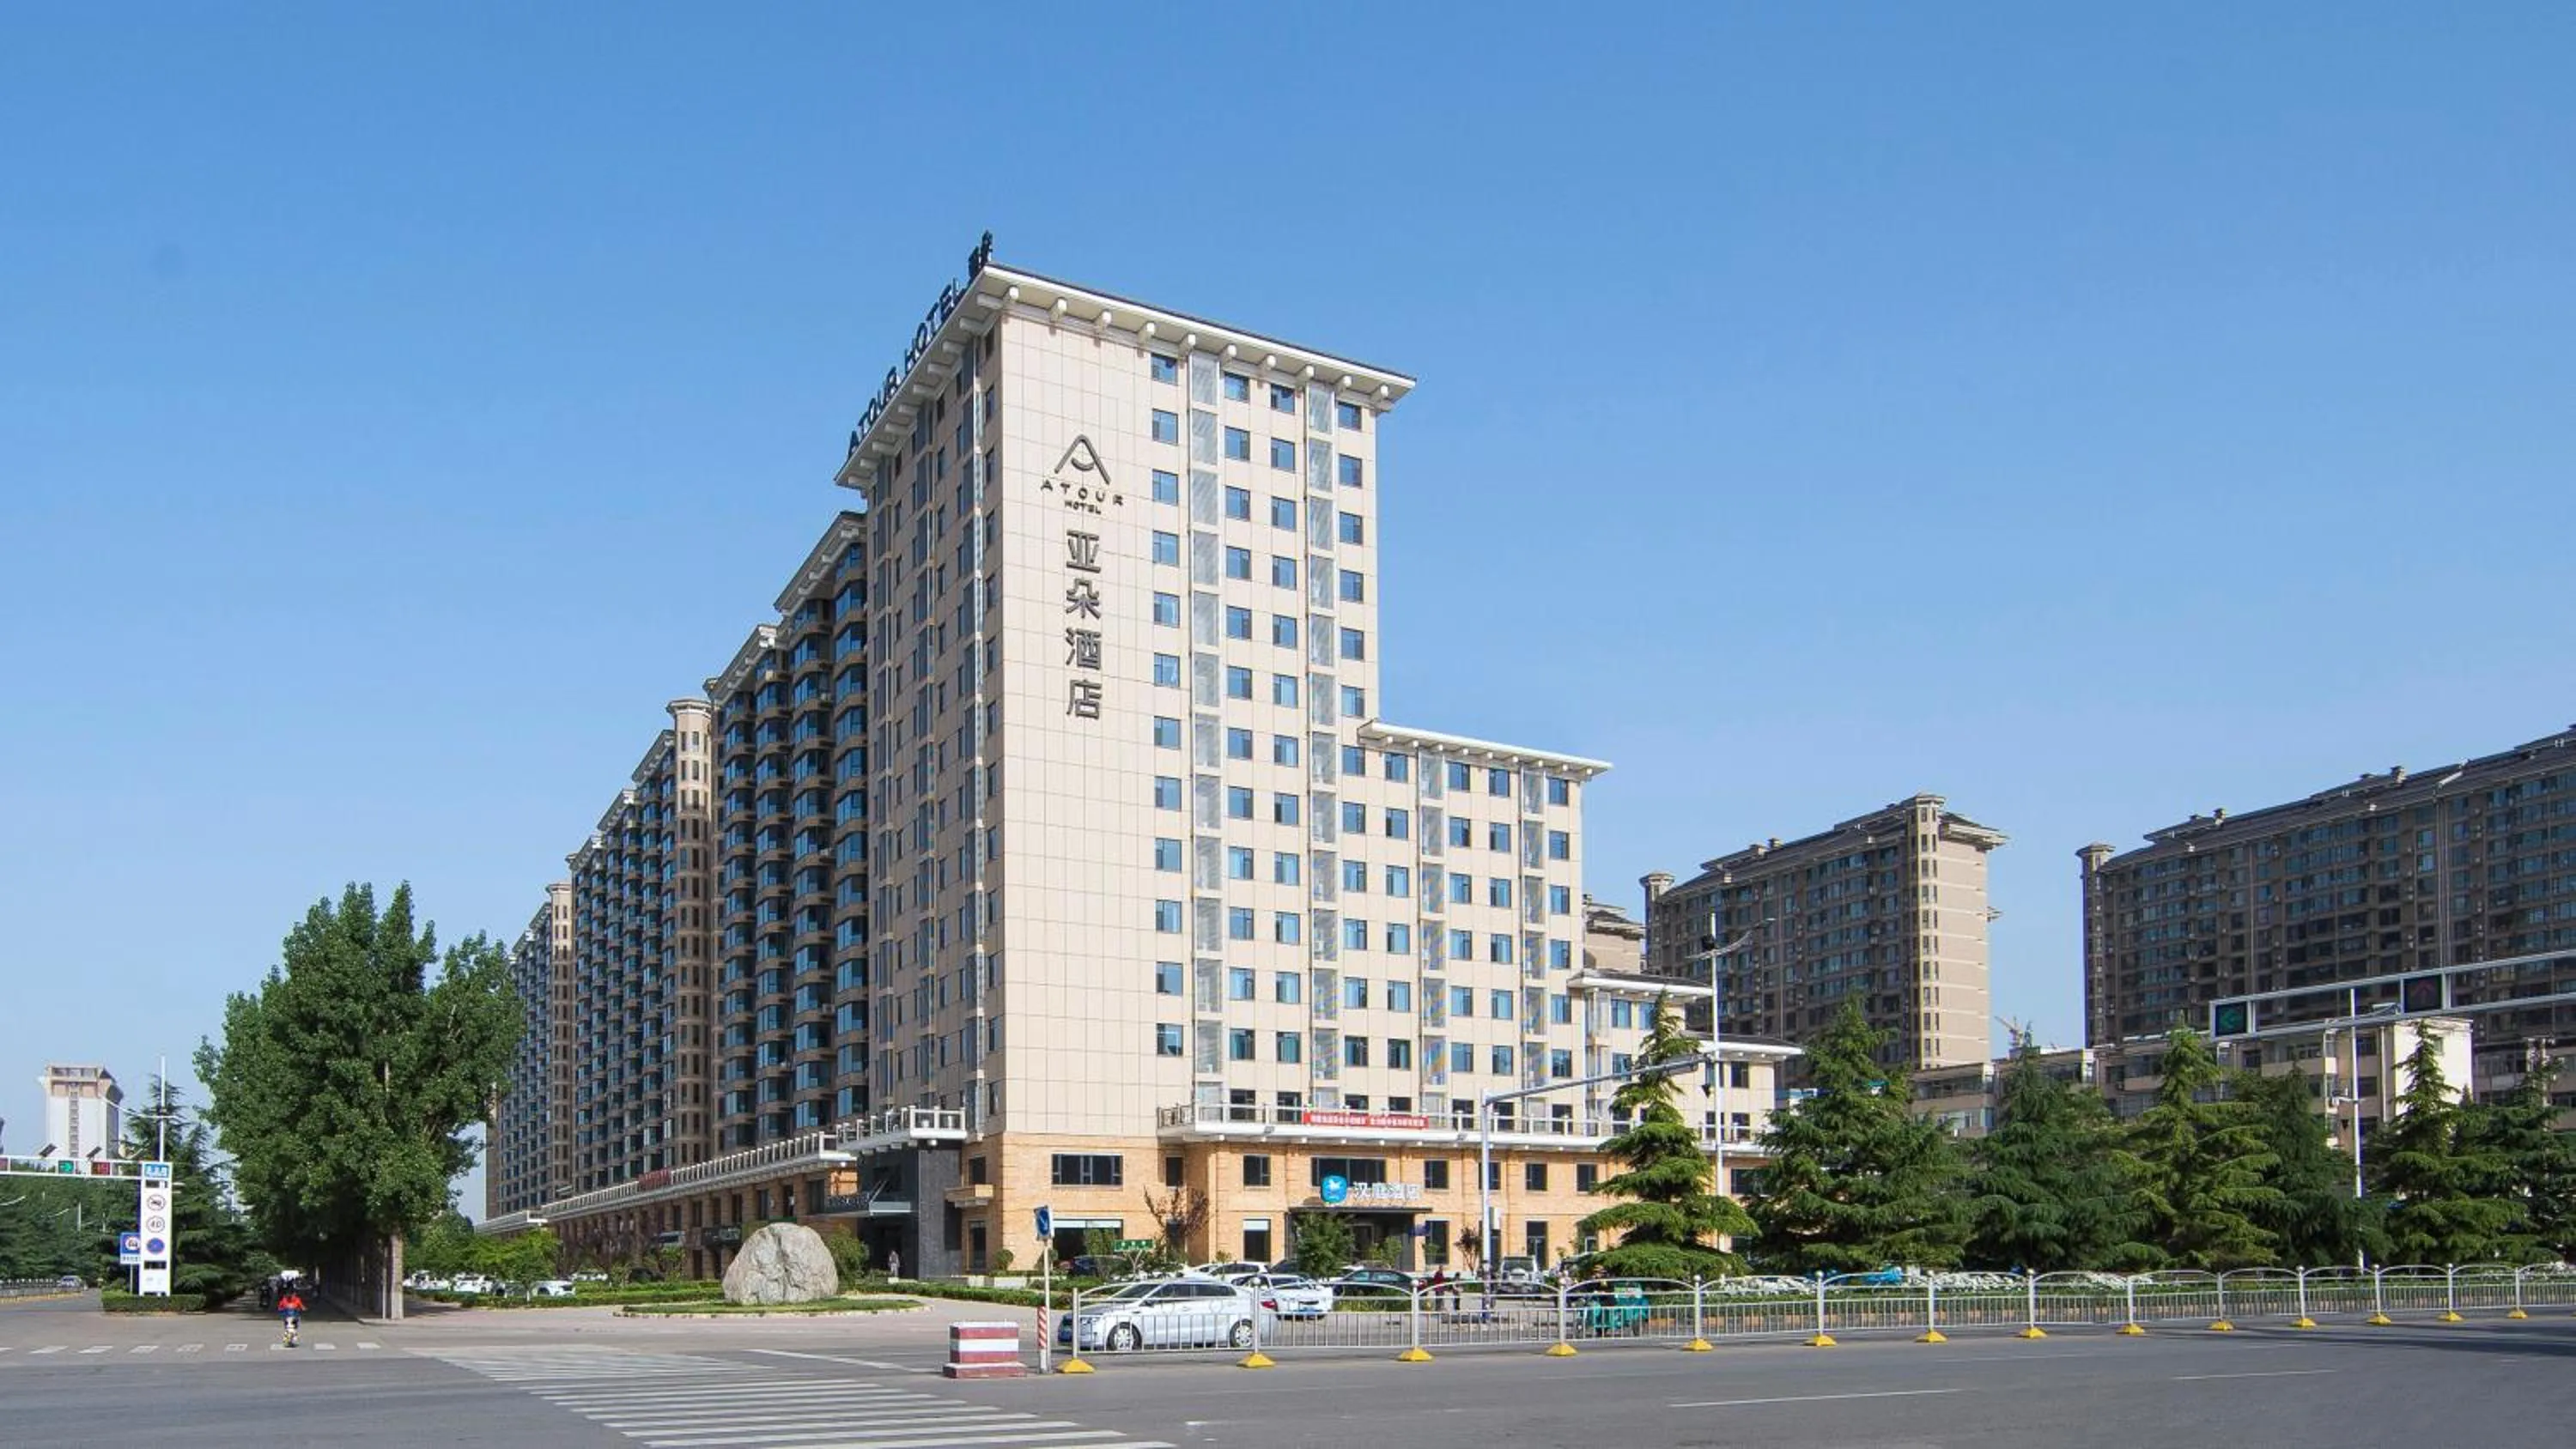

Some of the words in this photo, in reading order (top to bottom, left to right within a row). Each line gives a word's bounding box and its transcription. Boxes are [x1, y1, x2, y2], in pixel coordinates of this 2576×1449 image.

[848, 365, 902, 460] ATOUR
[904, 276, 968, 374] HOTEL
[1041, 479, 1123, 506] ATOUR
[1064, 500, 1102, 515] HOTEL
[1065, 529, 1103, 720] 亚朵酒店
